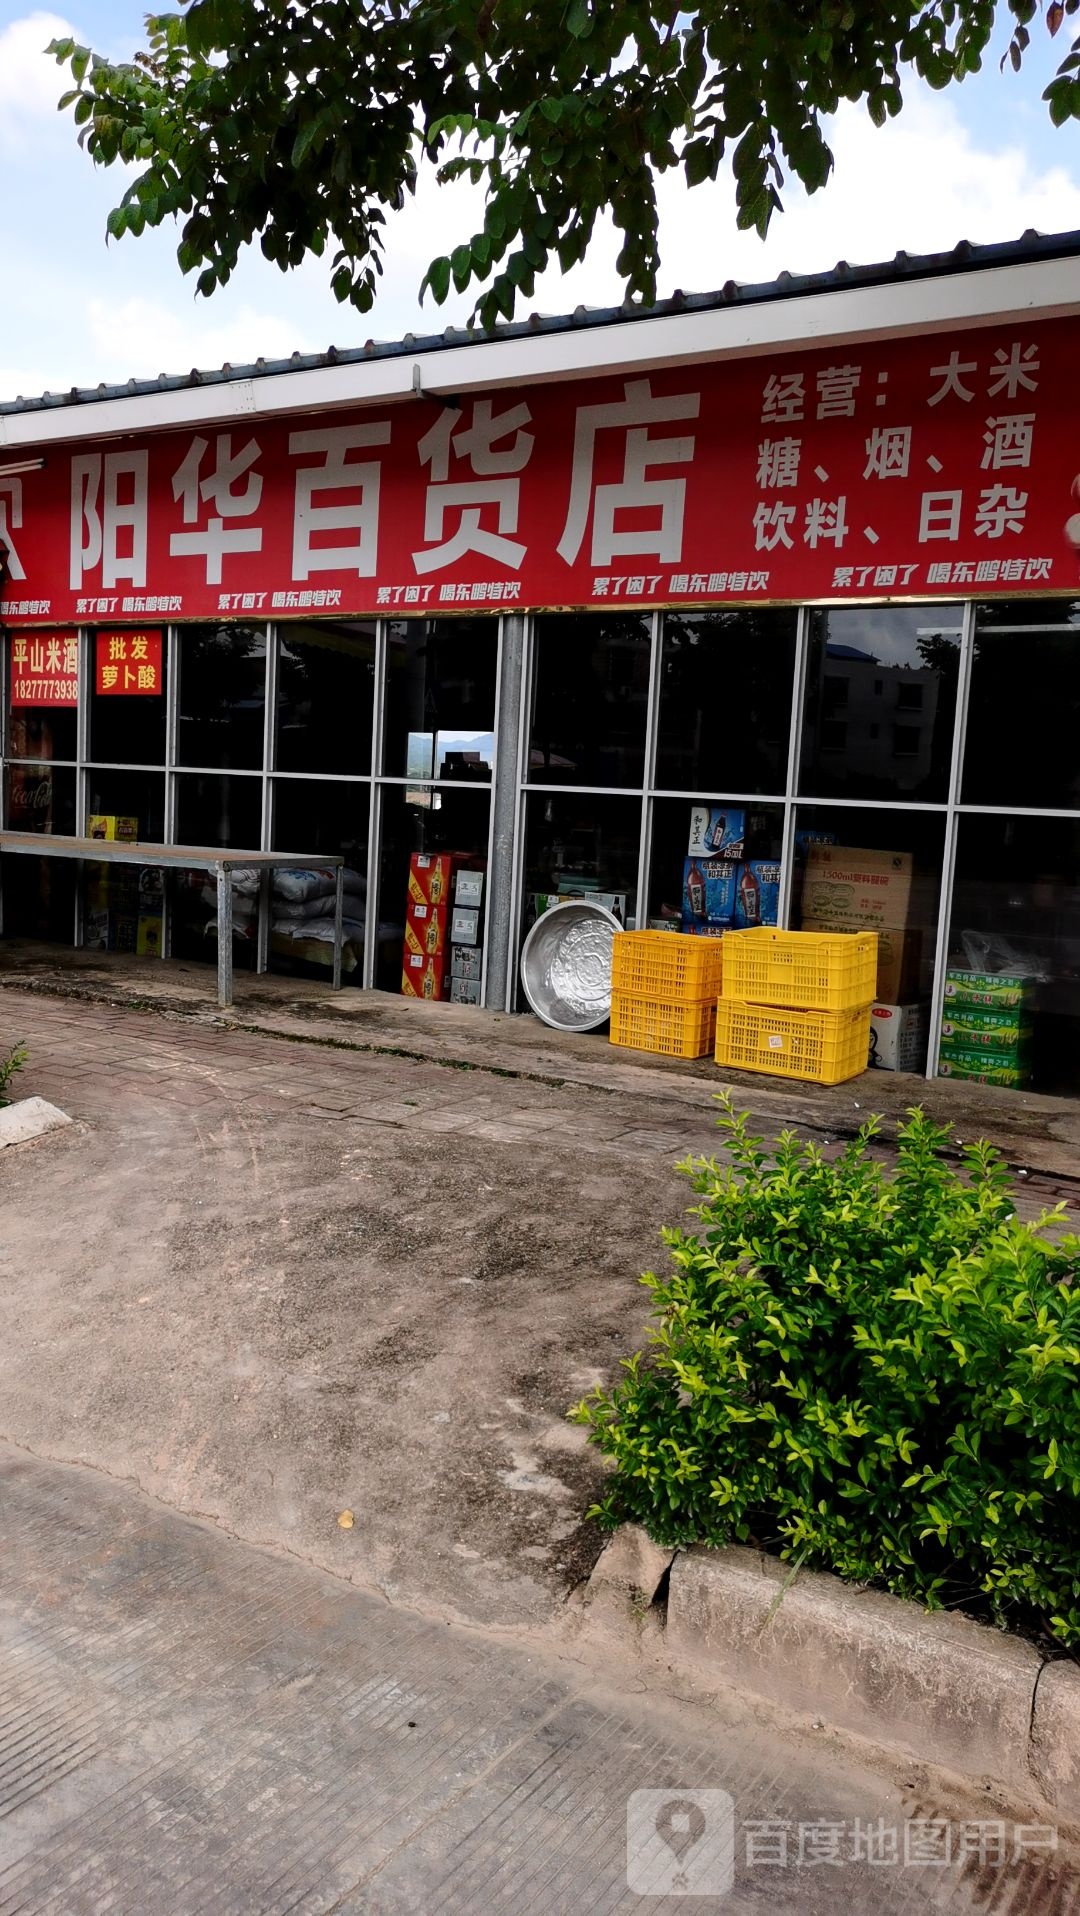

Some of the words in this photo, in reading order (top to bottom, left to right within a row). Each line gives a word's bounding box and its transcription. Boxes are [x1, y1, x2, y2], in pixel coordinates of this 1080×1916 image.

[756, 412, 1036, 490] 糖、烟、酒
[752, 483, 1029, 552] 饮料、日杂
[591, 576, 663, 596] 累了困了
[669, 571, 770, 593] 喝东鹏特饮
[831, 565, 919, 588] 累了困了
[927, 558, 1053, 583] 喝东鹏特饮
[76, 598, 118, 613] 累了困了
[122, 596, 182, 612] 喝东鹏特饮
[218, 593, 267, 610] 累了困了
[272, 589, 342, 607] 喝东鹏特饮
[376, 586, 434, 604] 累了困了
[439, 582, 521, 602] 喝东鹏特饮
[13, 637, 78, 674] 平山米酒
[109, 636, 149, 661] 批发
[15, 680, 78, 699] 18277773938
[102, 665, 156, 689] 萝卜酸
